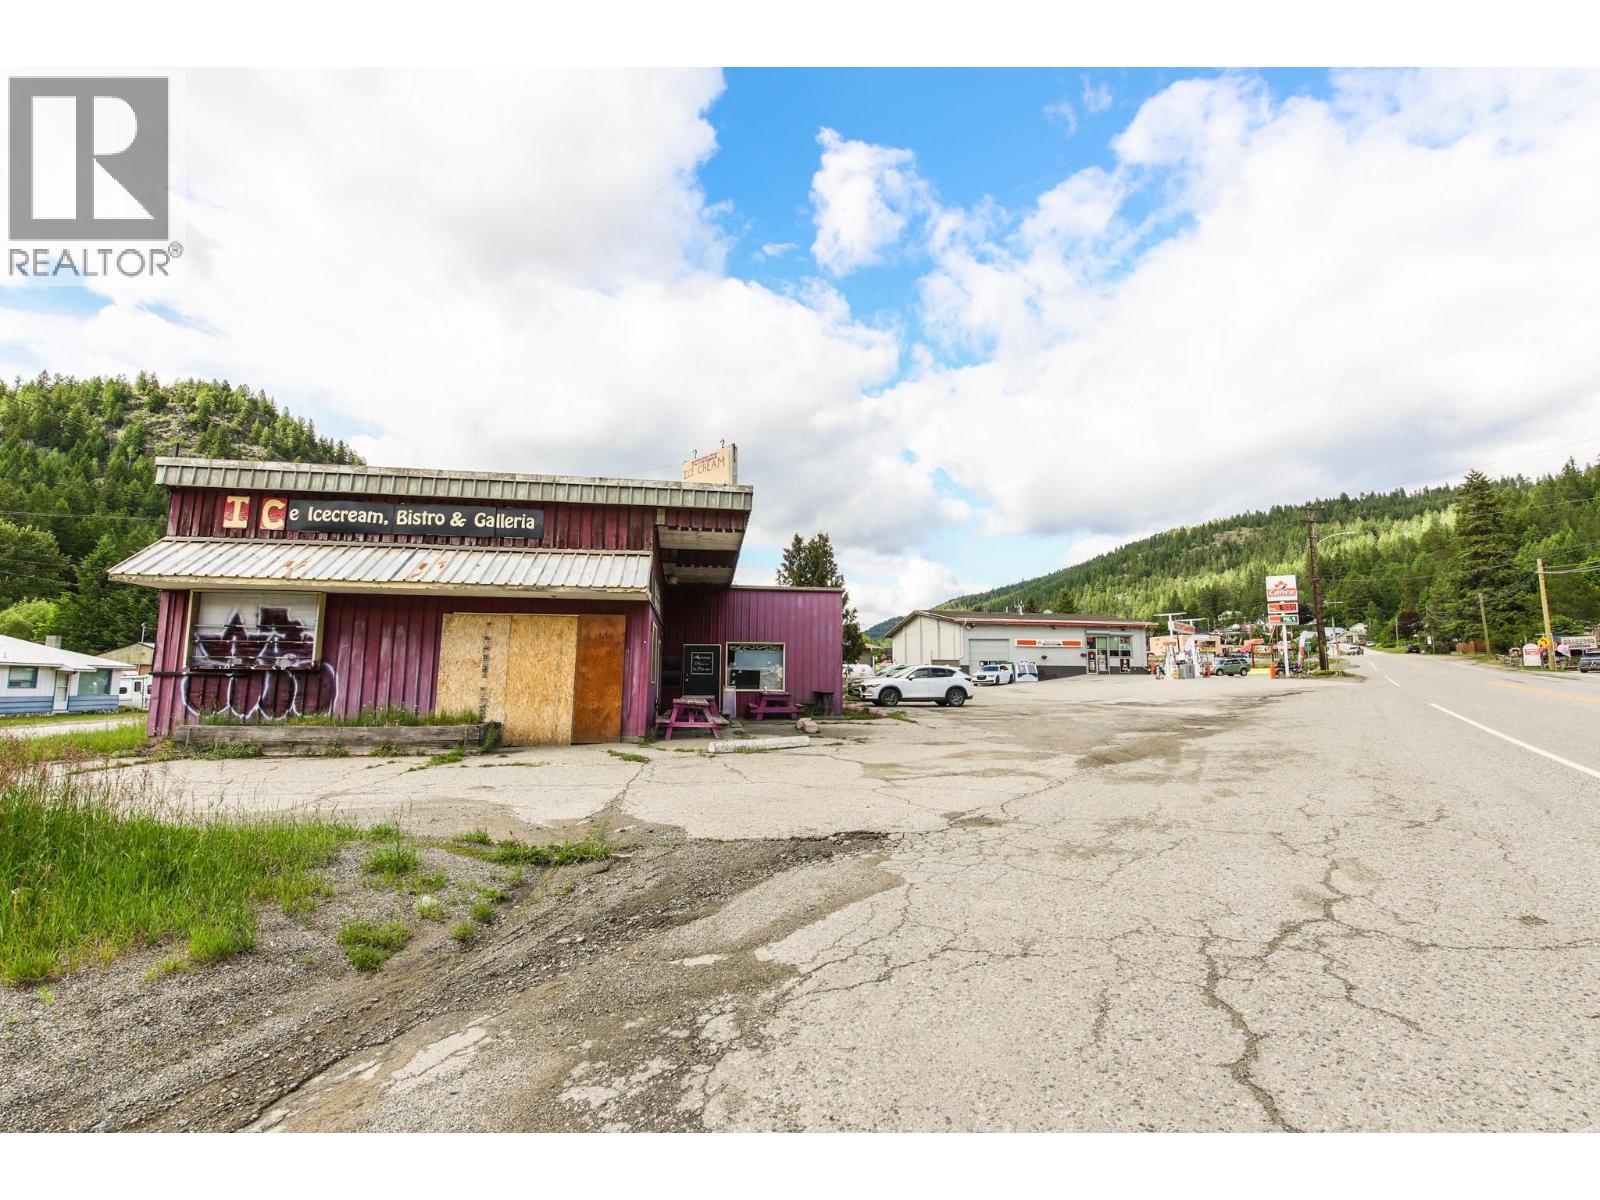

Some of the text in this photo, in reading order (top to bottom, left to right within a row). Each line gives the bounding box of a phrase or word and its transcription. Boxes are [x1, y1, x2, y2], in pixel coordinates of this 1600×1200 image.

[697, 456, 726, 474] CREAM
[307, 506, 389, 526] Icecream,
[396, 509, 446, 526] Bistro
[449, 511, 467, 528] &
[474, 512, 535, 529] Galleria
